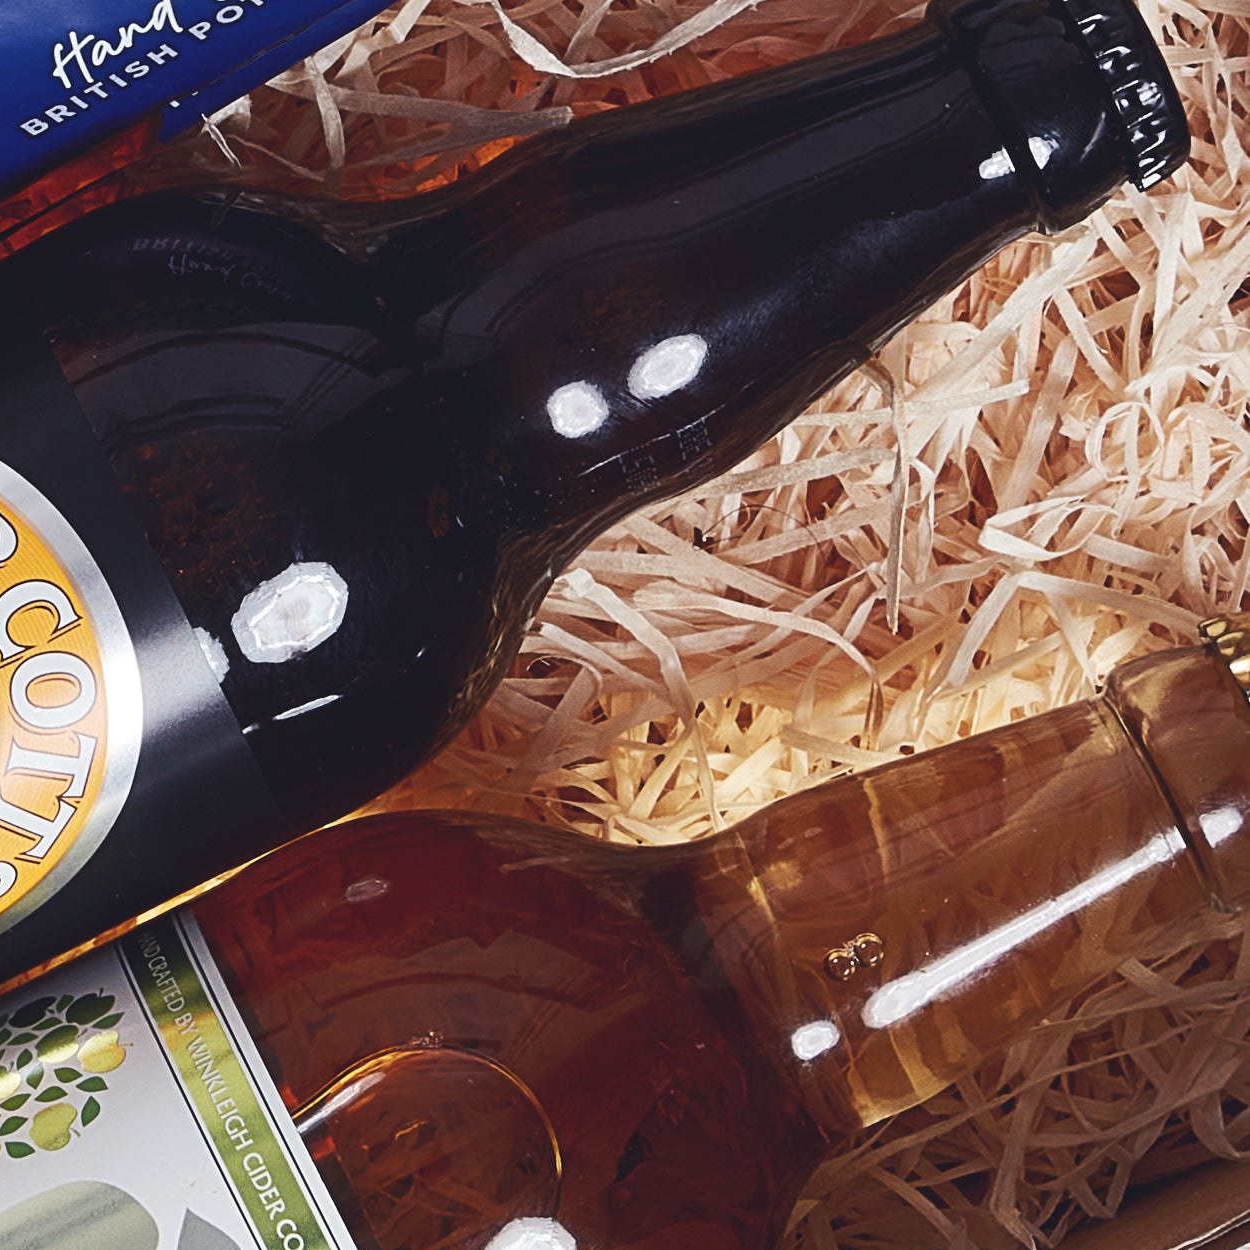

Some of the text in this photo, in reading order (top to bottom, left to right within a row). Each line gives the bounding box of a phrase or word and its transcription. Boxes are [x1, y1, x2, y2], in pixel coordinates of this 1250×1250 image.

[20, 0, 264, 136] BRITISH PO
[174, 1012, 198, 1036] BY
[186, 1036, 253, 1152] WINKLEIGH
[242, 1151, 285, 1221] CIDER
